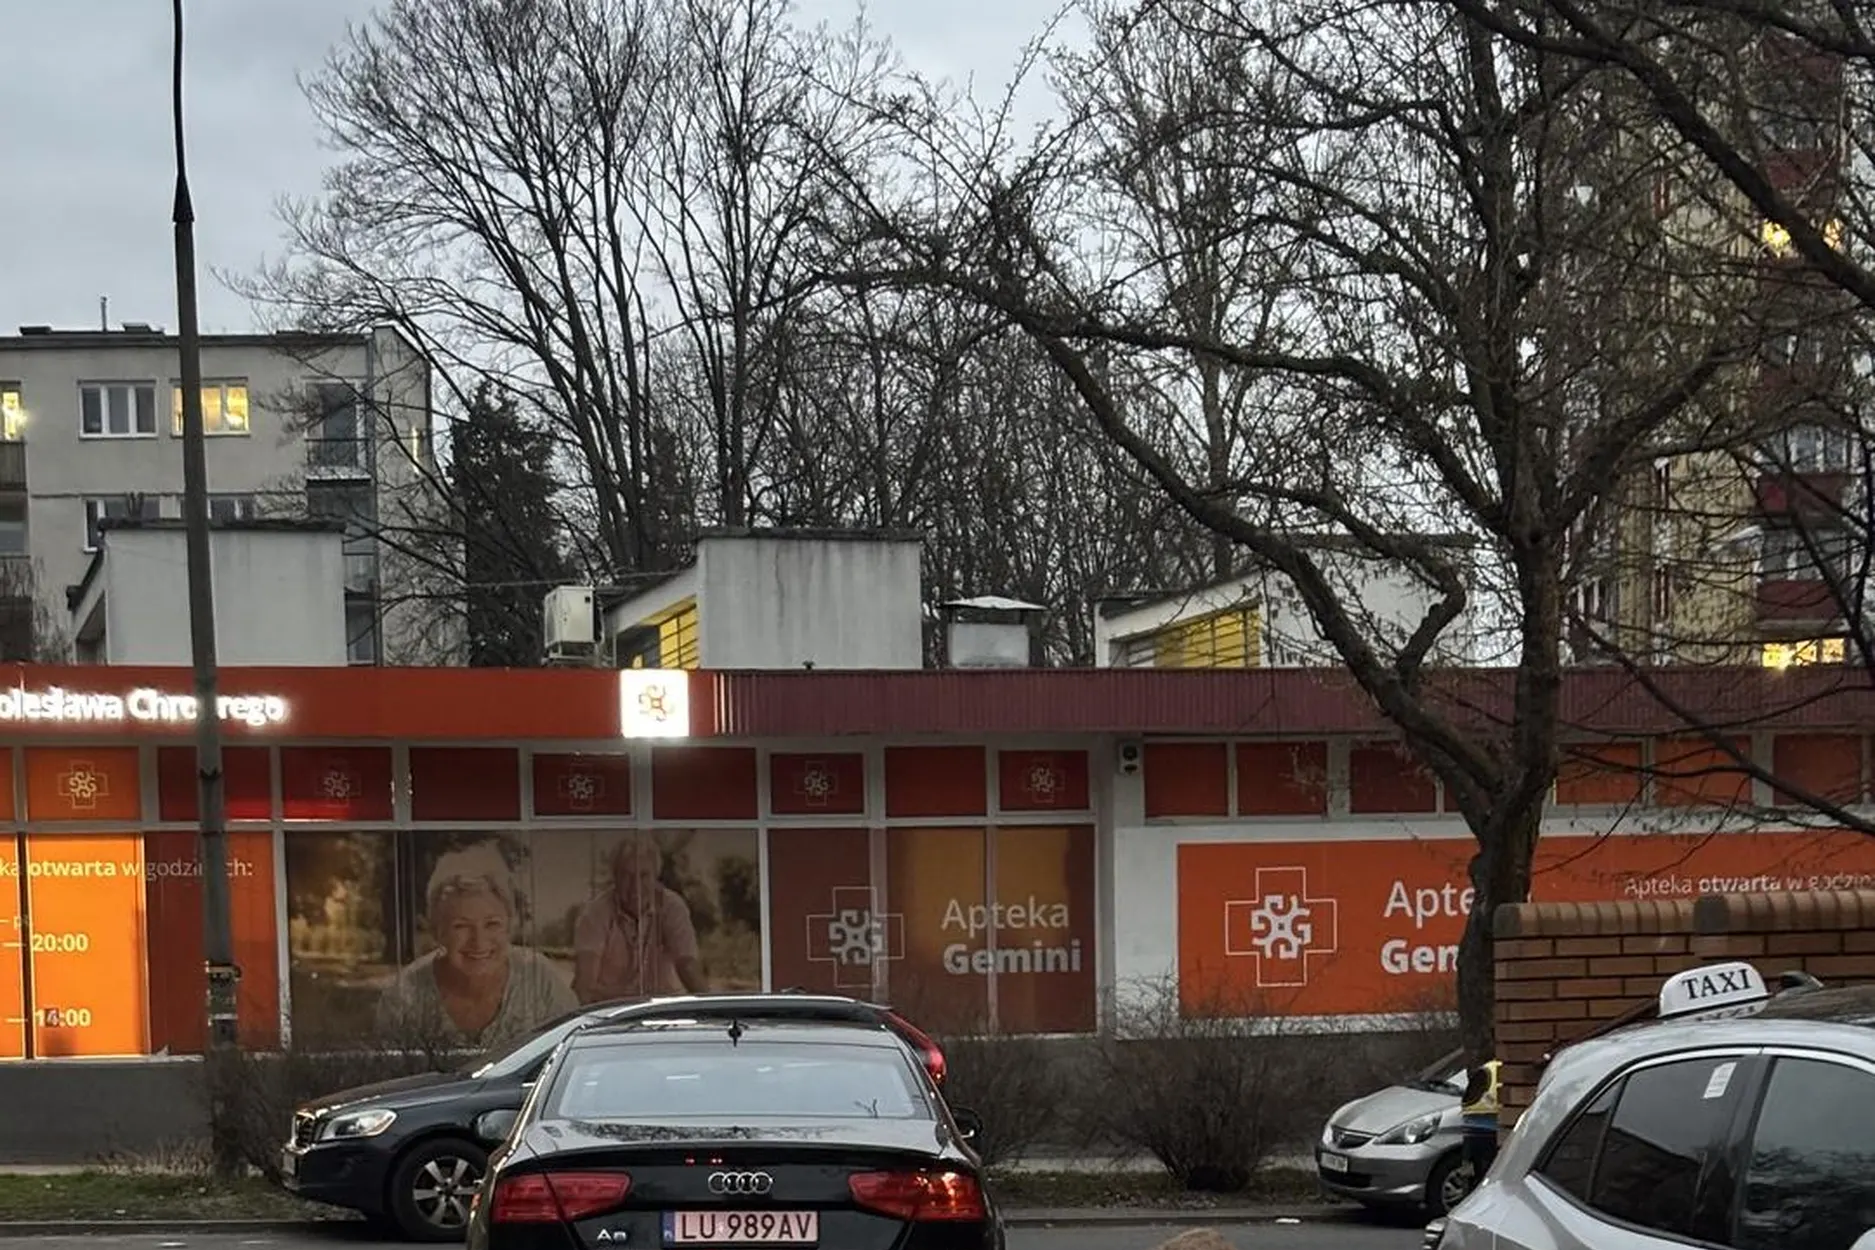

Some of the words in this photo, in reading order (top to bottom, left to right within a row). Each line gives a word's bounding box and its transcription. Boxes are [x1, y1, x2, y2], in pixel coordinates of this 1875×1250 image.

[128, 687, 285, 726] Chrorego
[29, 859, 116, 877] otwarta
[1624, 875, 1693, 899] Apteka
[1698, 874, 1781, 893] otwarta
[940, 895, 1070, 938] Apteka
[1383, 879, 1476, 929] Apte
[33, 933, 89, 952] 20:00
[943, 938, 1082, 975] Gemini
[1682, 968, 1752, 999] TAXI
[681, 1214, 716, 1239] LU
[727, 1213, 812, 1239] 989AV
